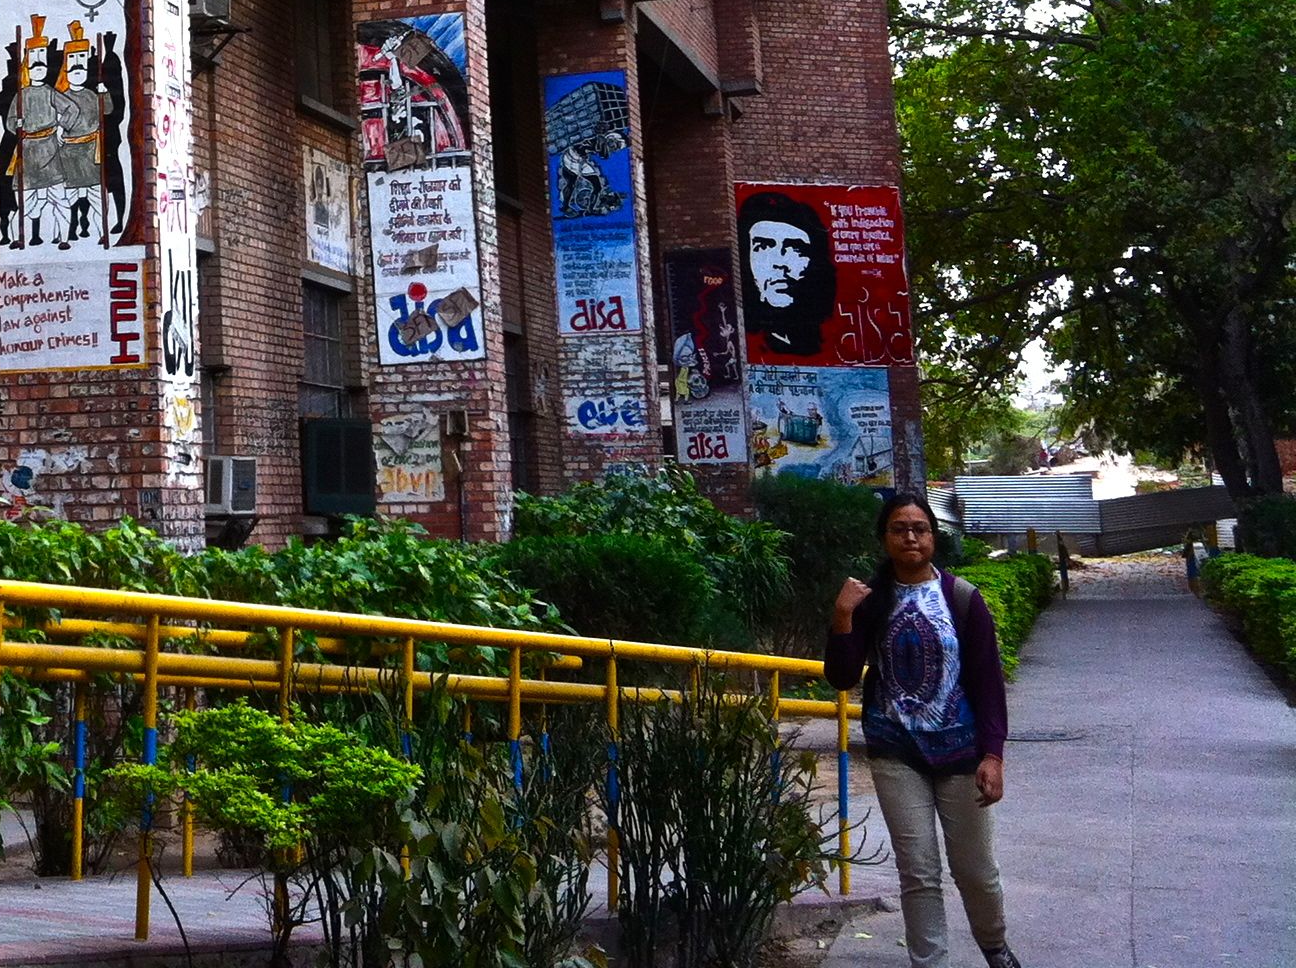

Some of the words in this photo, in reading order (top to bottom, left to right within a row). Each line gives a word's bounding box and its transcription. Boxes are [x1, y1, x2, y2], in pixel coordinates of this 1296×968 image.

[35, 272, 44, 286] a
[24, 305, 72, 334] against
[110, 263, 140, 364] SFI
[570, 296, 627, 331] aisa
[687, 432, 729, 460] aisa
